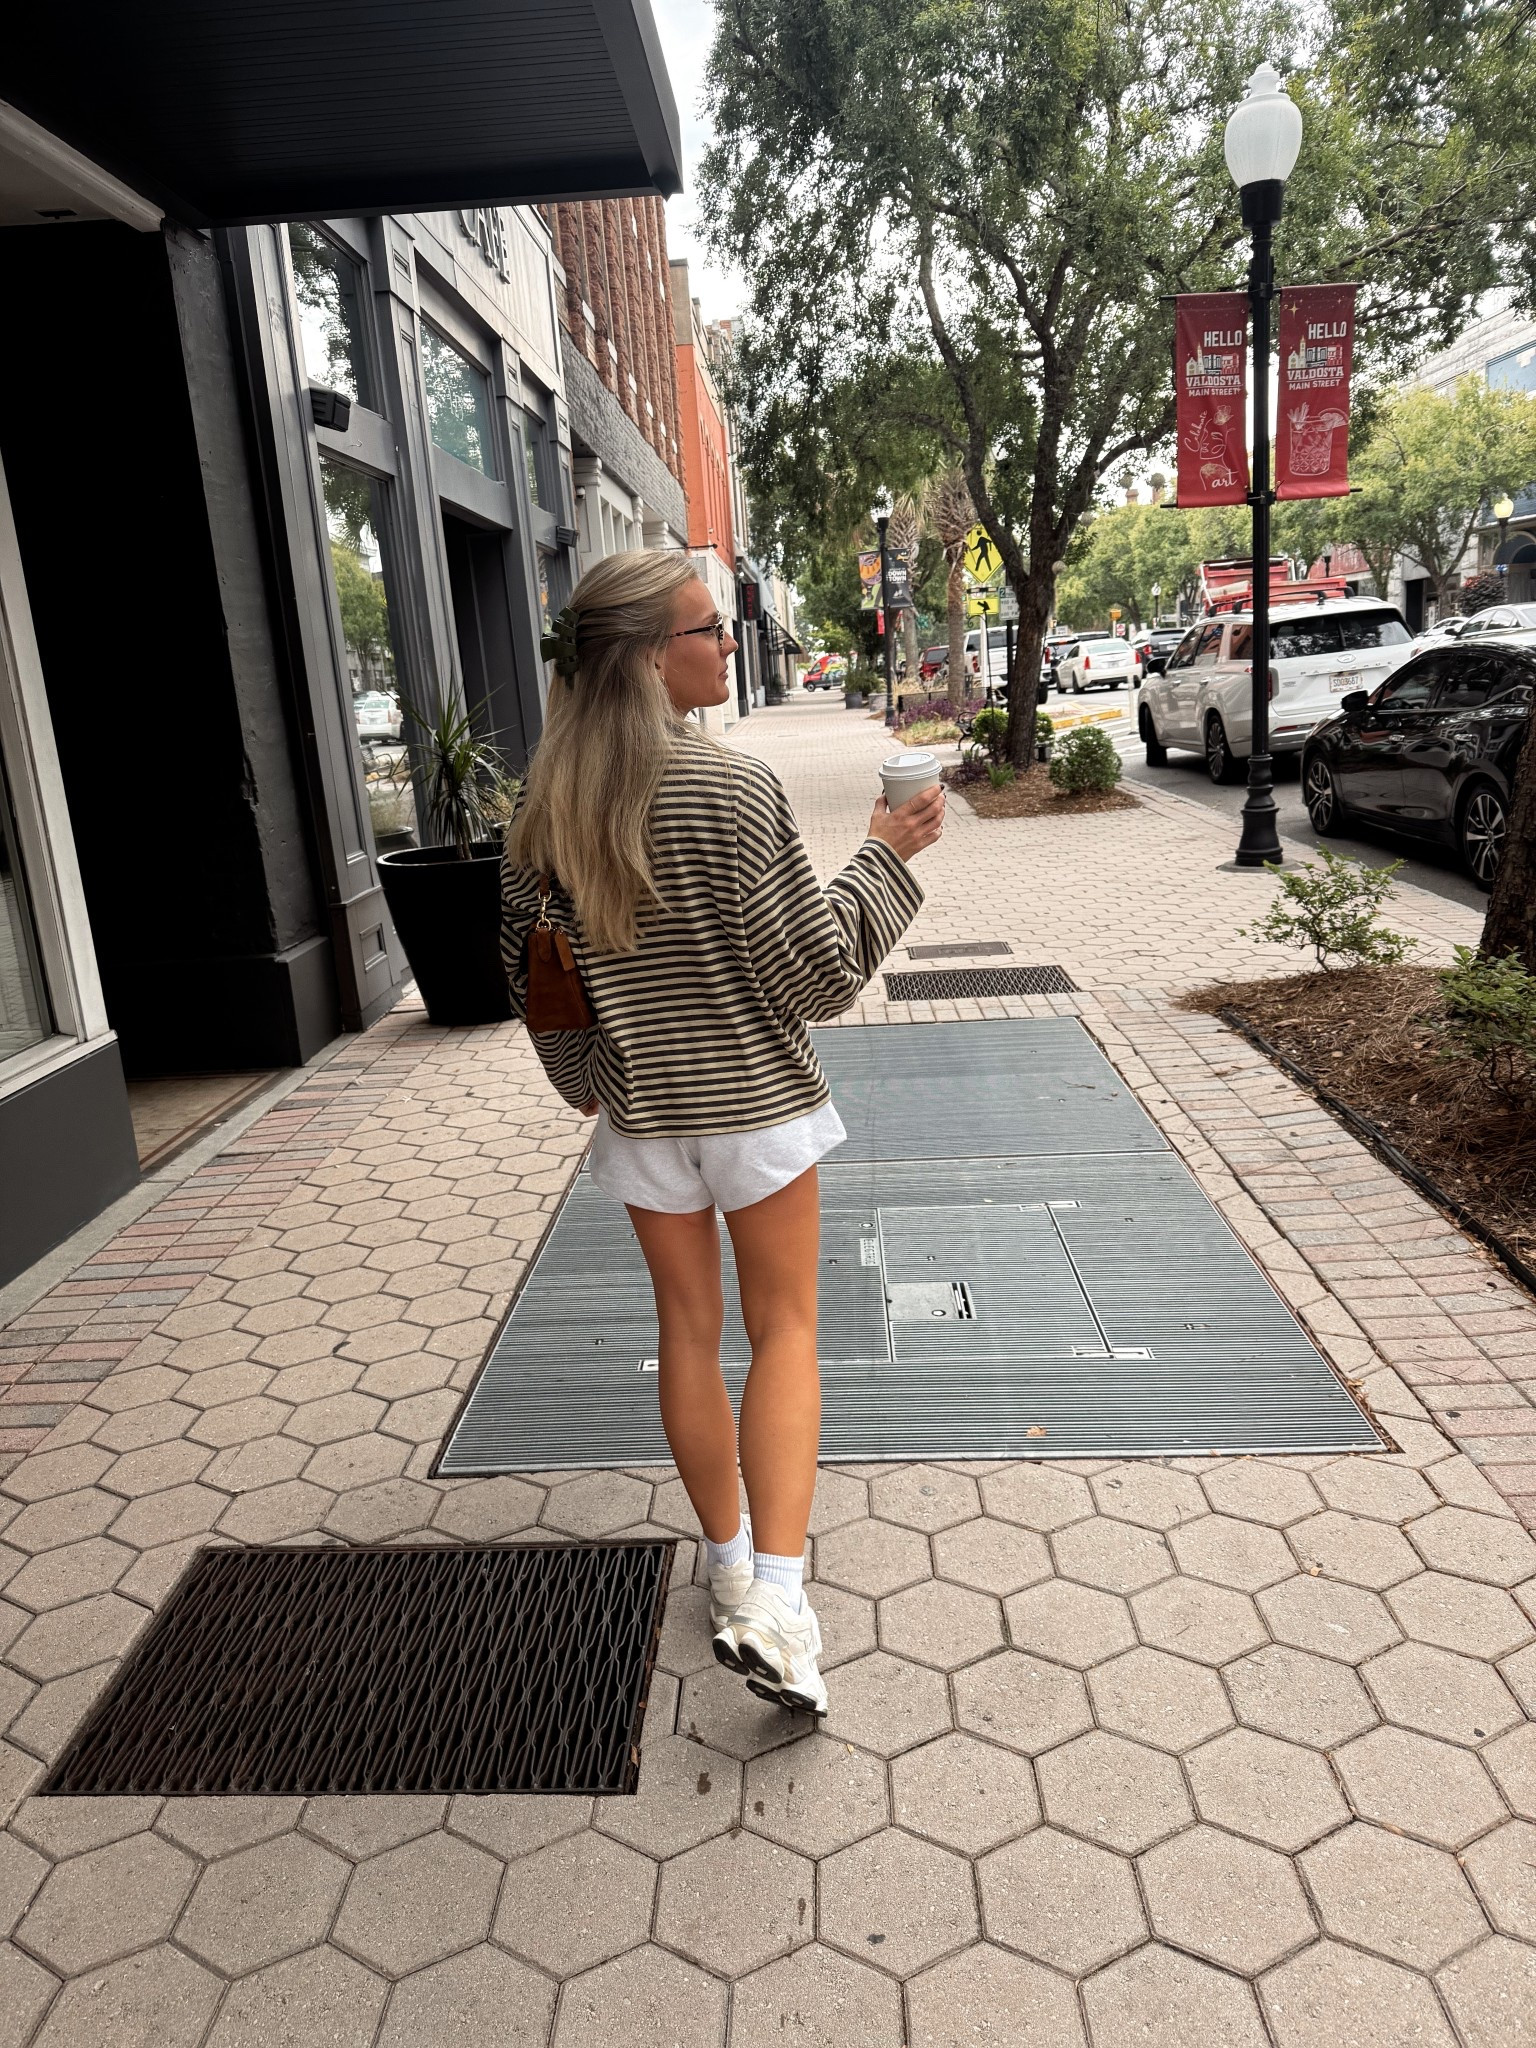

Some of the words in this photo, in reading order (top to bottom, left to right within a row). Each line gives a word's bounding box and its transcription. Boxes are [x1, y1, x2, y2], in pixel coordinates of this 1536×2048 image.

[1308, 321, 1347, 339] HELLO
[1204, 330, 1243, 347] HELLO
[1287, 366, 1344, 380] VALDOSTA
[1186, 375, 1241, 387] VALDOSTA
[1289, 382, 1310, 391] MAIN
[1312, 379, 1341, 388] STREET
[1189, 388, 1210, 397] MAIN
[1211, 387, 1237, 395] STREET
[1211, 469, 1239, 488] art
